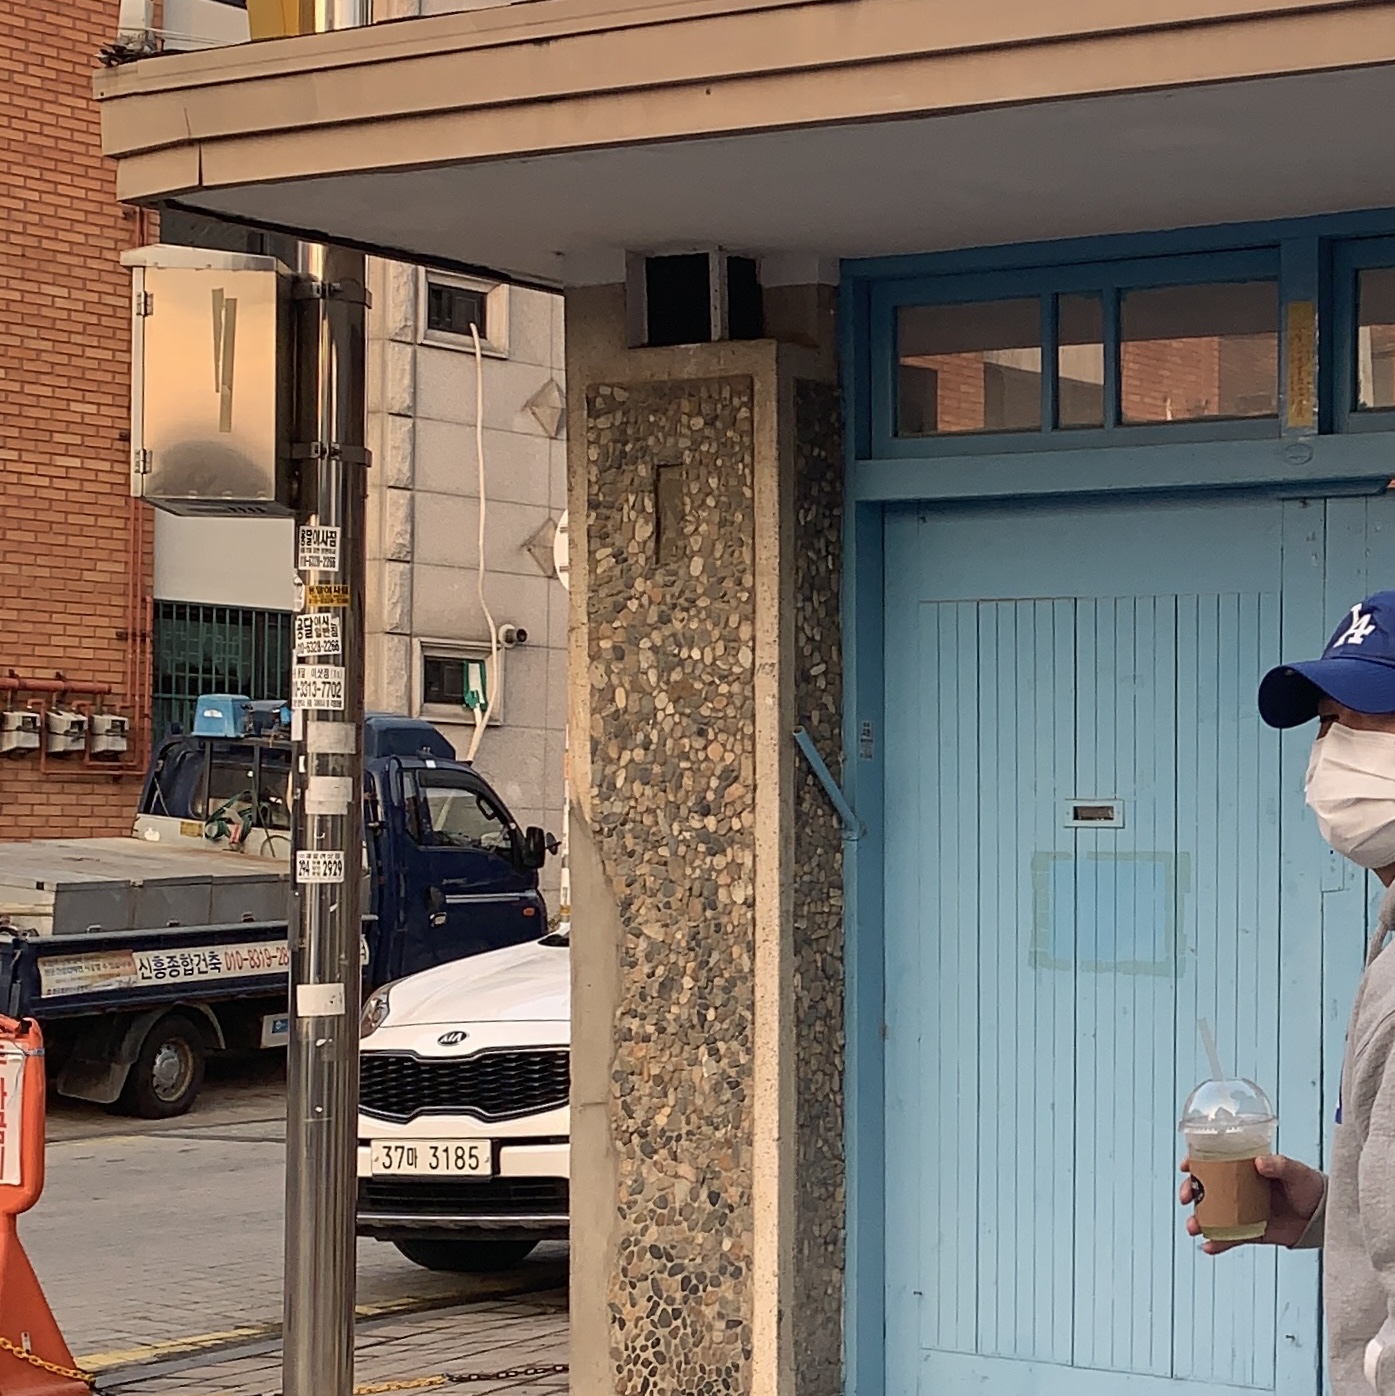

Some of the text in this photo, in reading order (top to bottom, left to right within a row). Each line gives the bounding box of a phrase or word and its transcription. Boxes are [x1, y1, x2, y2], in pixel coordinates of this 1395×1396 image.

[138, 951, 222, 980] 신흥종합건축
[382, 1146, 479, 1170] 37마 3185
